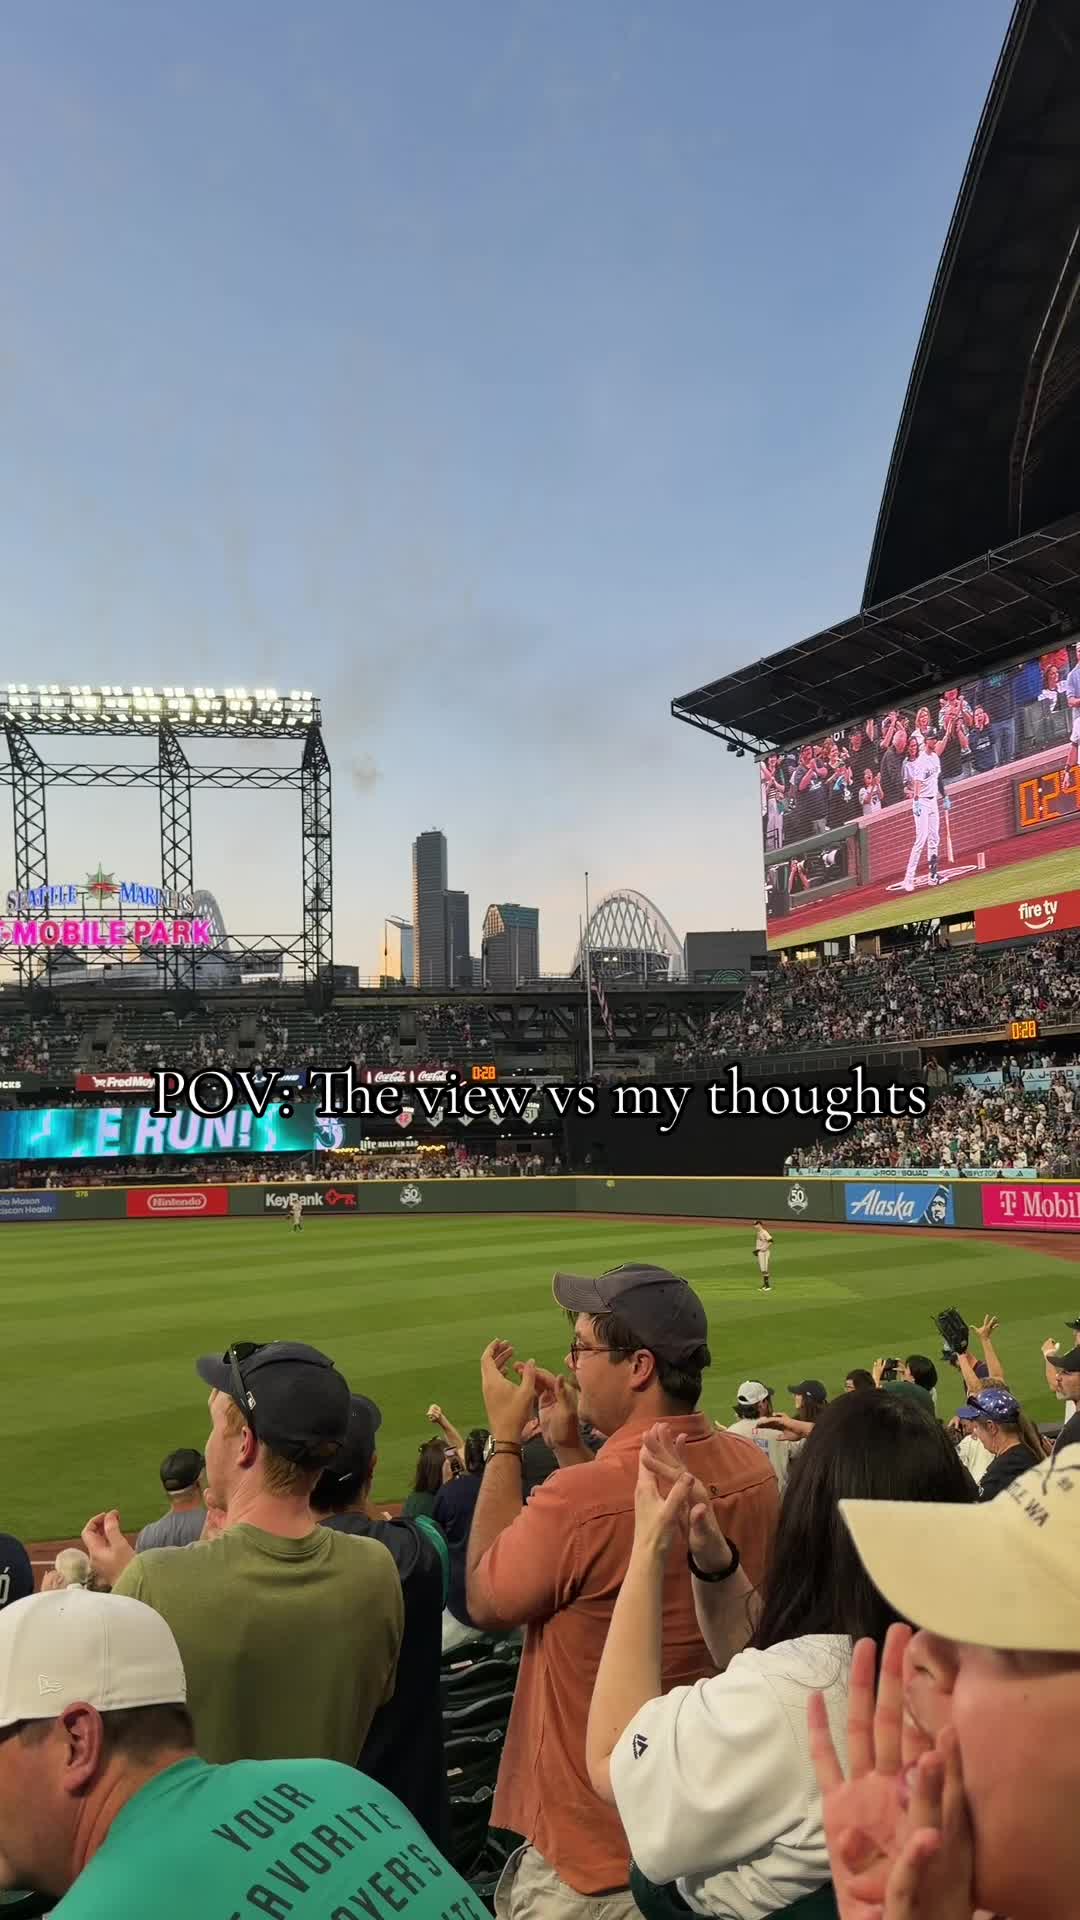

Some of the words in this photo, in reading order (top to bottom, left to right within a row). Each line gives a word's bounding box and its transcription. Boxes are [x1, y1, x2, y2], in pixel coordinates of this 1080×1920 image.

[7, 884, 78, 912] SEATTLE
[119, 881, 195, 913] MARINERS
[1018, 903, 1042, 920] fire
[1044, 900, 1058, 916] tv
[133, 919, 213, 946] PARK
[1011, 1020, 1037, 1040] 0:28
[375, 1070, 407, 1083] Coca-Cola
[471, 1066, 496, 1081] 0:28
[132, 1111, 252, 1154] RUN!
[152, 1196, 202, 1207] Nintendo
[265, 1192, 324, 1209] KeyBank
[791, 1190, 804, 1202] 50
[850, 1188, 915, 1221] Alaska
[211, 1783, 317, 1852] YOUR
[227, 1802, 402, 1920] AVORITE
